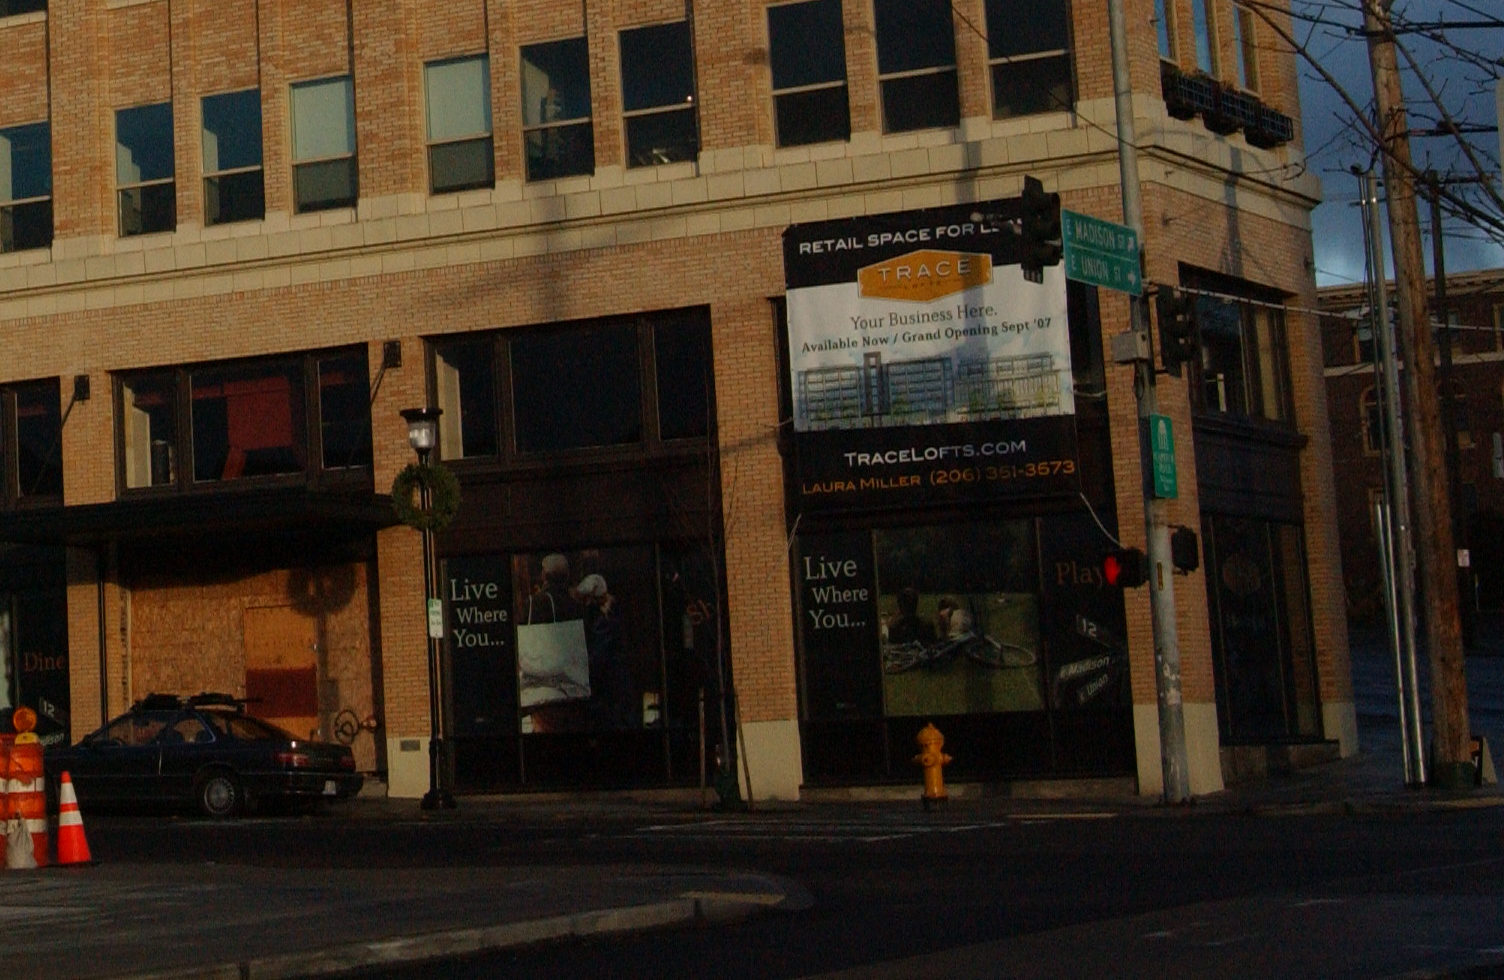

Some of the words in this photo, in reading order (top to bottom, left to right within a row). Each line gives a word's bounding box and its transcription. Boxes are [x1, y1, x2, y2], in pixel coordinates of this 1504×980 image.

[799, 236, 864, 255] RETAIL
[867, 227, 932, 248] SPACE
[935, 223, 975, 240] FOR
[1075, 220, 1116, 250] MADISON
[878, 259, 972, 282] TRACE
[1081, 255, 1109, 280] UNION
[850, 315, 884, 330] Your
[889, 309, 953, 327] Business
[957, 304, 998, 319] Here.
[802, 337, 858, 353] Available
[862, 335, 889, 347] Now
[902, 329, 941, 342] Grand
[945, 324, 998, 340] Opening
[1001, 320, 1029, 334] Sept
[801, 480, 856, 495] LAURA
[859, 474, 921, 490] MILLER
[929, 467, 981, 486] (206)
[803, 555, 857, 580] Live
[450, 578, 498, 601] Live
[811, 584, 869, 604] Where
[456, 606, 508, 624] Where
[808, 608, 866, 630] You...
[453, 628, 505, 649] You...
